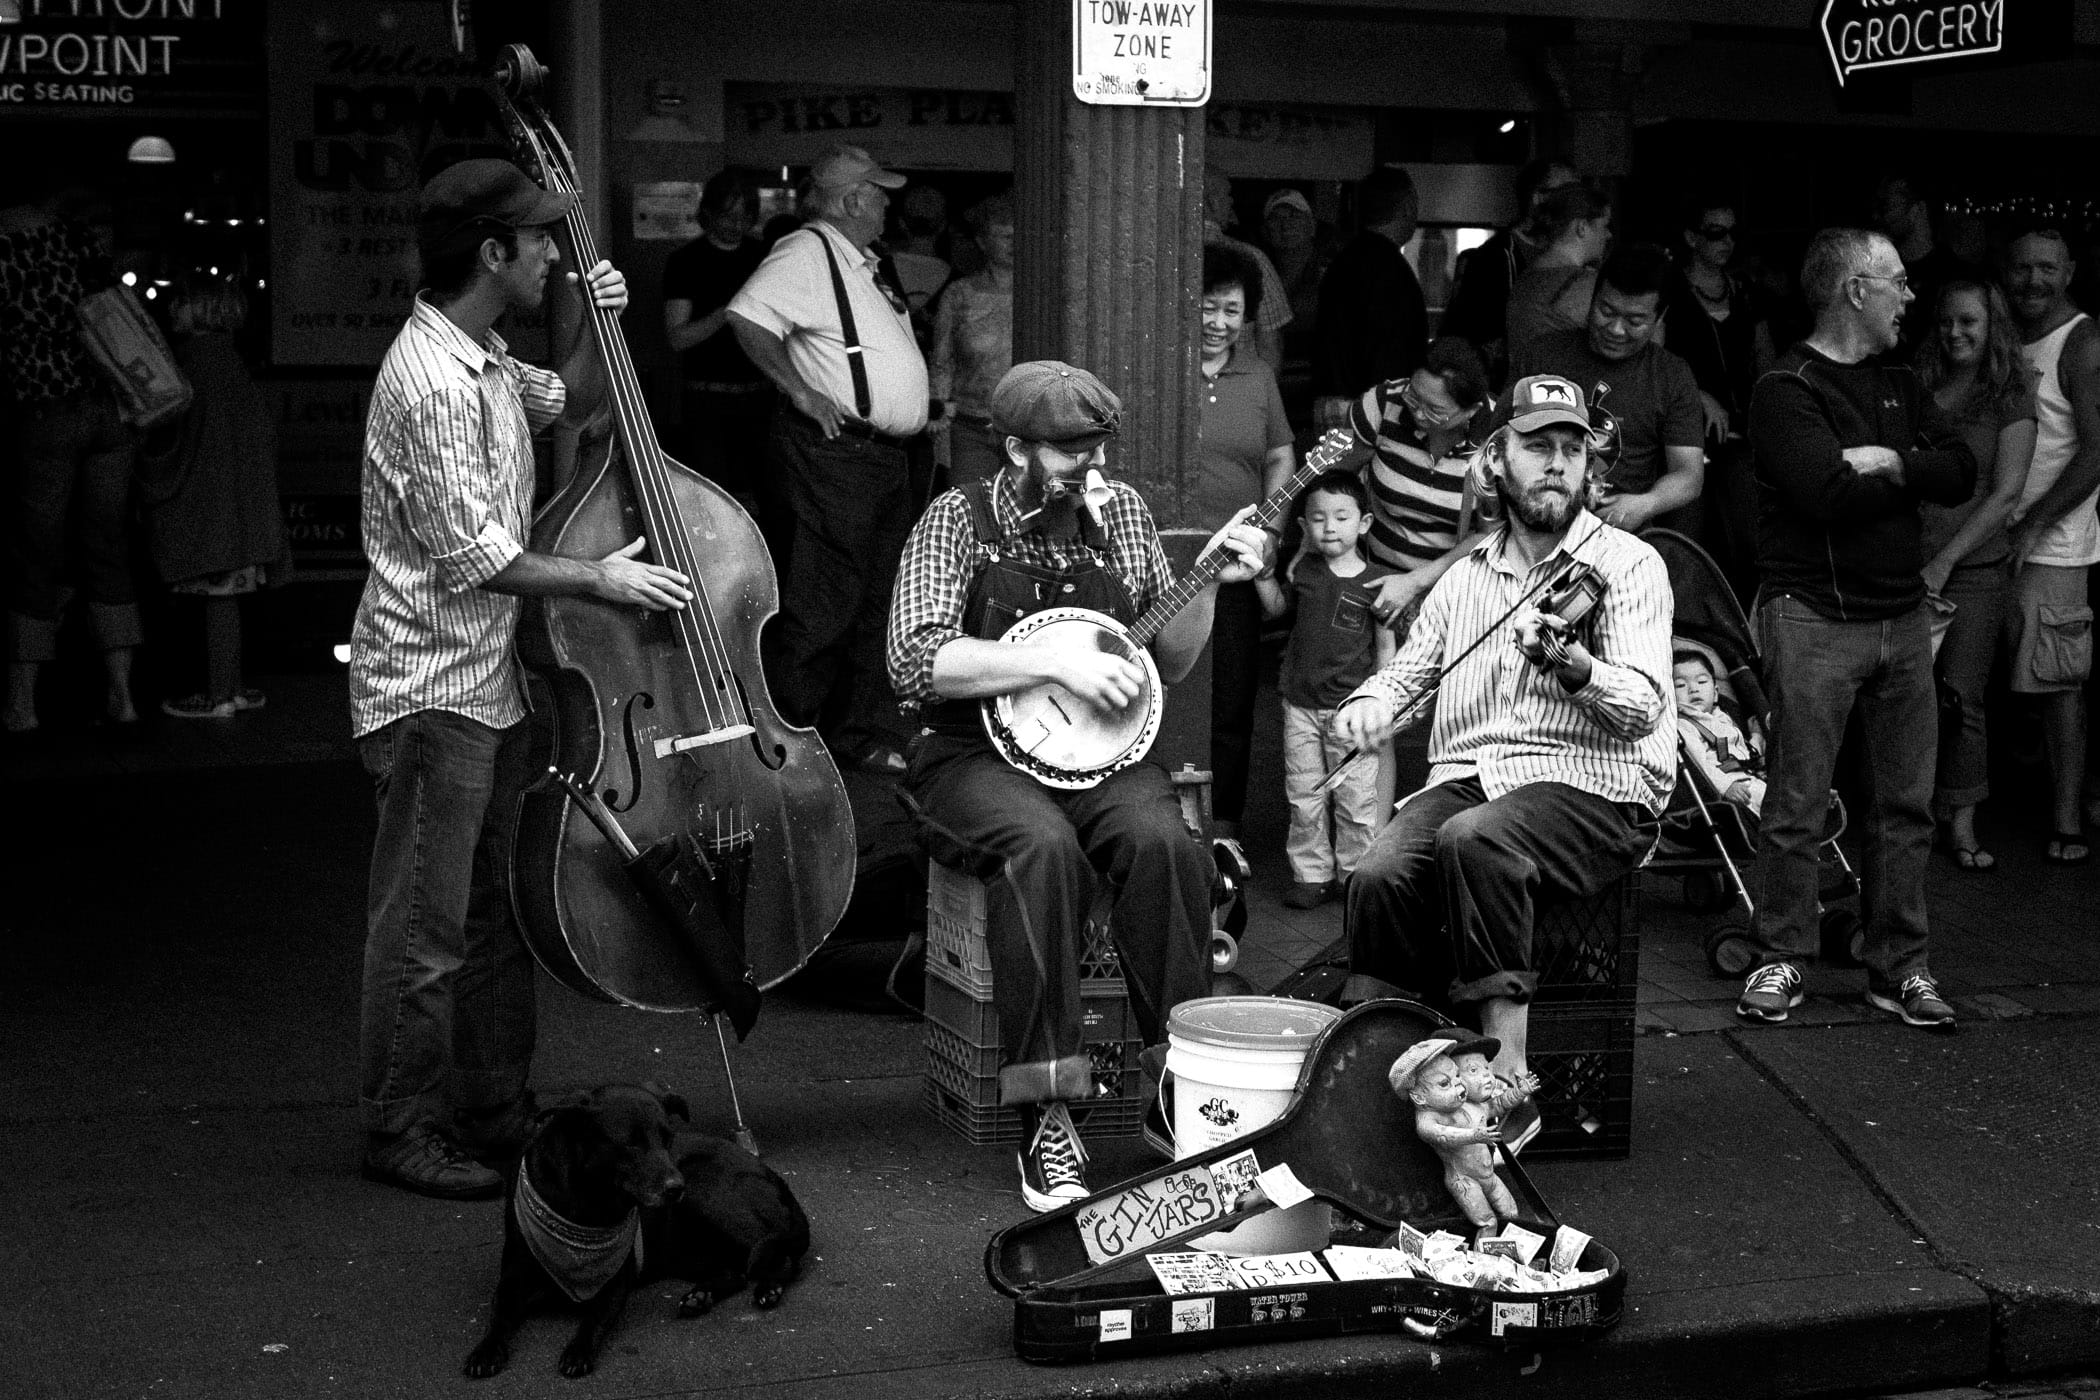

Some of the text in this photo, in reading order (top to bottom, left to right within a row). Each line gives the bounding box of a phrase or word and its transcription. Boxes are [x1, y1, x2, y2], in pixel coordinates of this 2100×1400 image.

[1088, 0, 1196, 28] TOW-AWAY
[1841, 0, 2000, 64] GROCERY
[1113, 34, 1172, 59] ZONE
[0, 81, 135, 104] IC SEATING
[742, 94, 881, 133] PIKE
[907, 90, 1015, 125] PLA
[305, 204, 351, 225] THE
[389, 277, 413, 300] FL
[291, 312, 338, 329] OVER
[369, 312, 409, 329] SHO
[288, 501, 315, 520] IC
[289, 522, 347, 541] OMS
[1209, 1097, 1229, 1114] GC
[1079, 1208, 1099, 1230] THE
[1094, 1186, 1155, 1257] GIN
[1144, 1182, 1215, 1240] JARS
